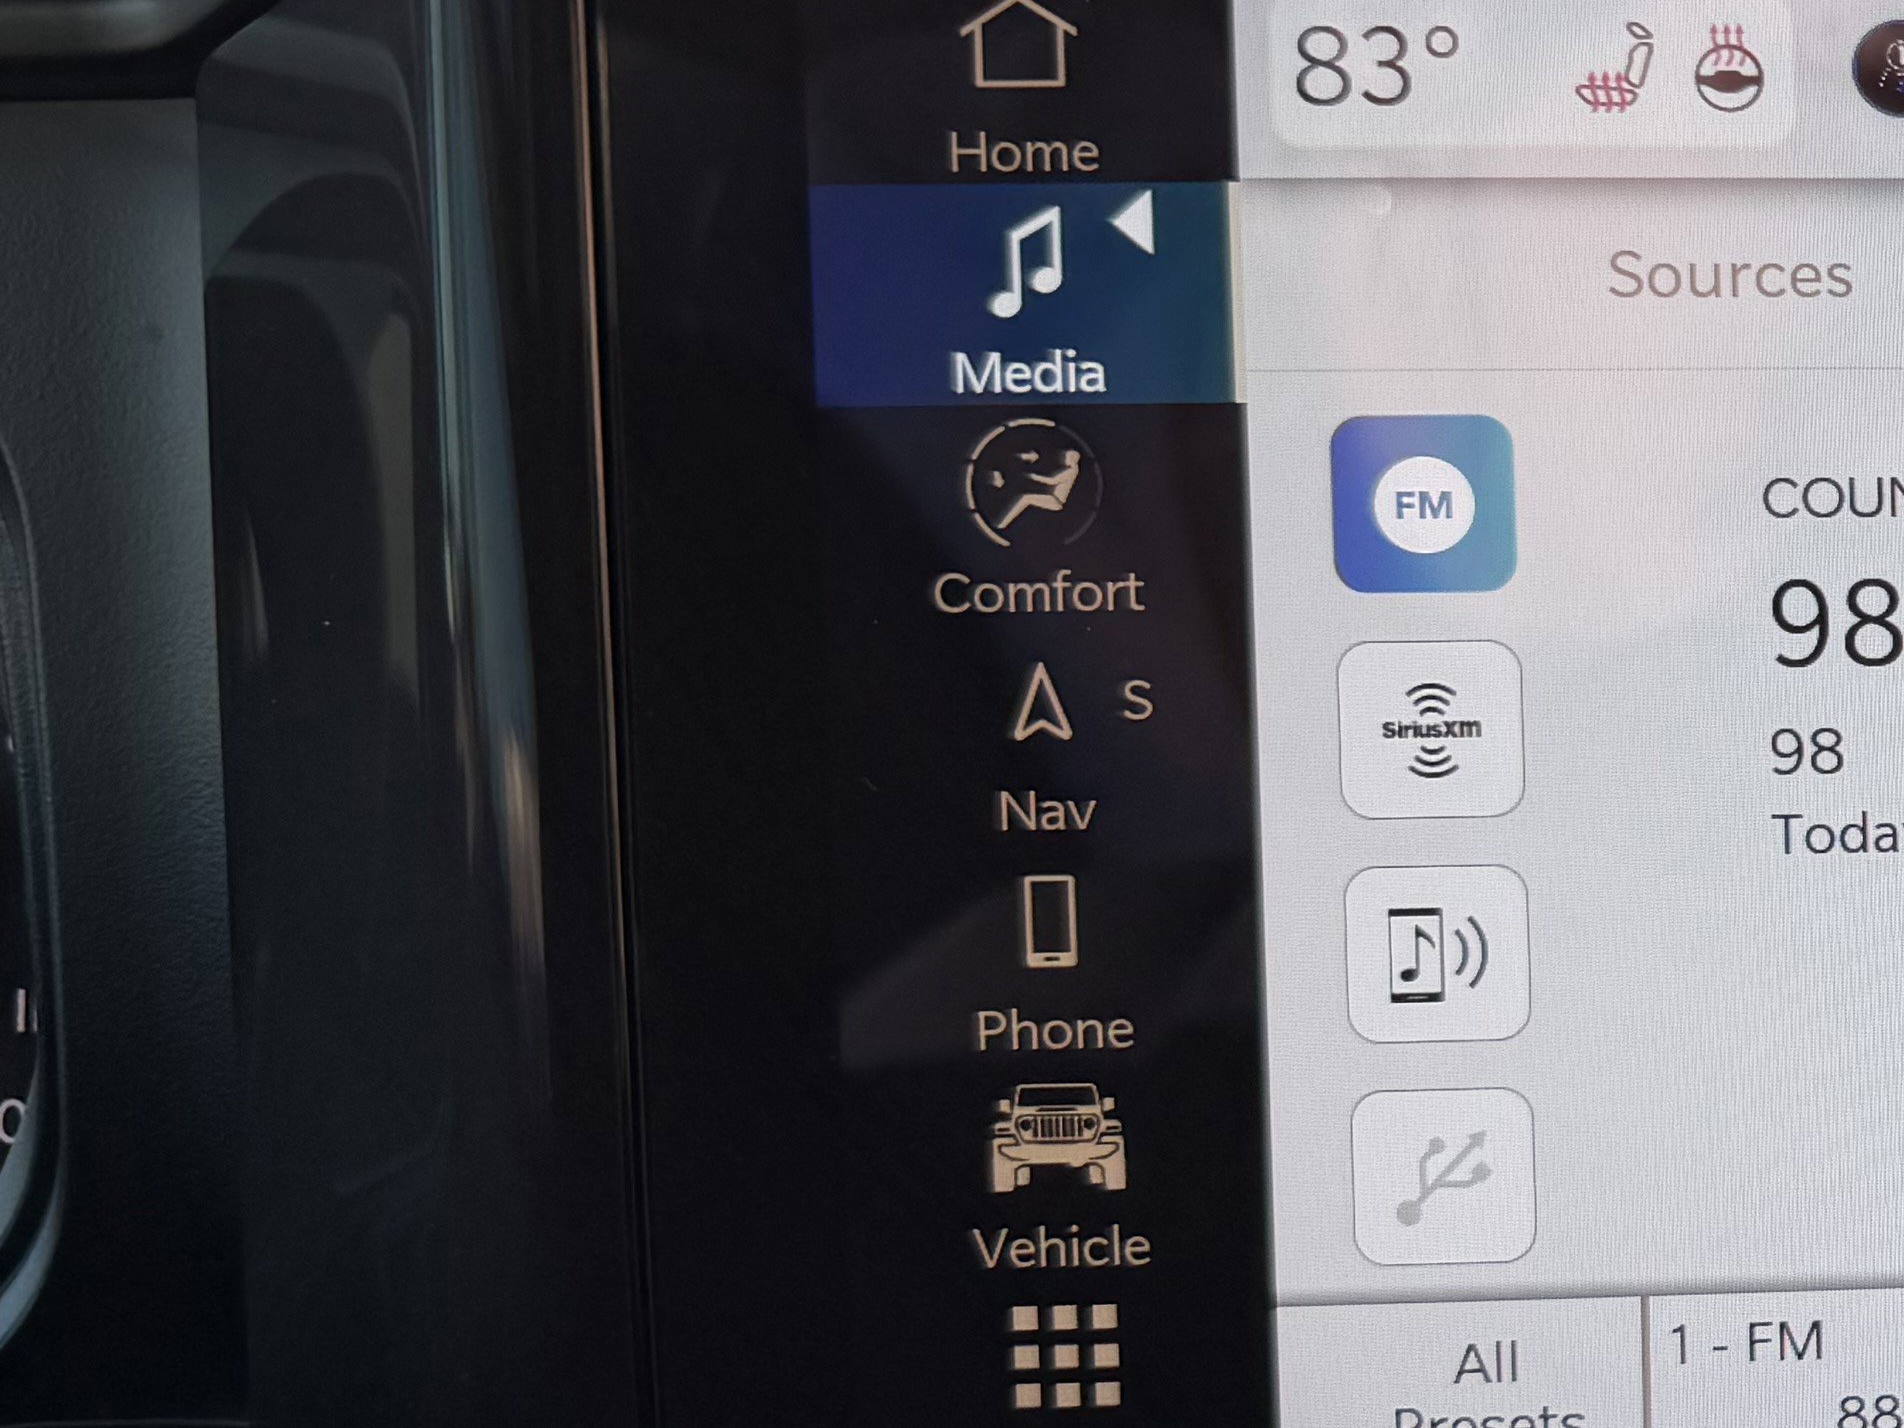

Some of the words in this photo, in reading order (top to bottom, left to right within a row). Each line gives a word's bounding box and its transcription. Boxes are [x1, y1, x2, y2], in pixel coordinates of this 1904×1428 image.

[949, 131, 1101, 174] Home
[1608, 250, 1853, 299] Sources
[948, 349, 1107, 396] Media
[1395, 490, 1454, 521] FM
[933, 569, 1146, 615] Comfort
[1122, 678, 1155, 721] S
[1771, 727, 1845, 776] 98
[998, 791, 1097, 833] Nav
[976, 1009, 1136, 1053] Phone
[973, 1224, 1153, 1269] Vehicle
[1452, 1339, 1519, 1385] All
[1672, 1324, 1690, 1366] 1
[1747, 1321, 1826, 1362] FM
